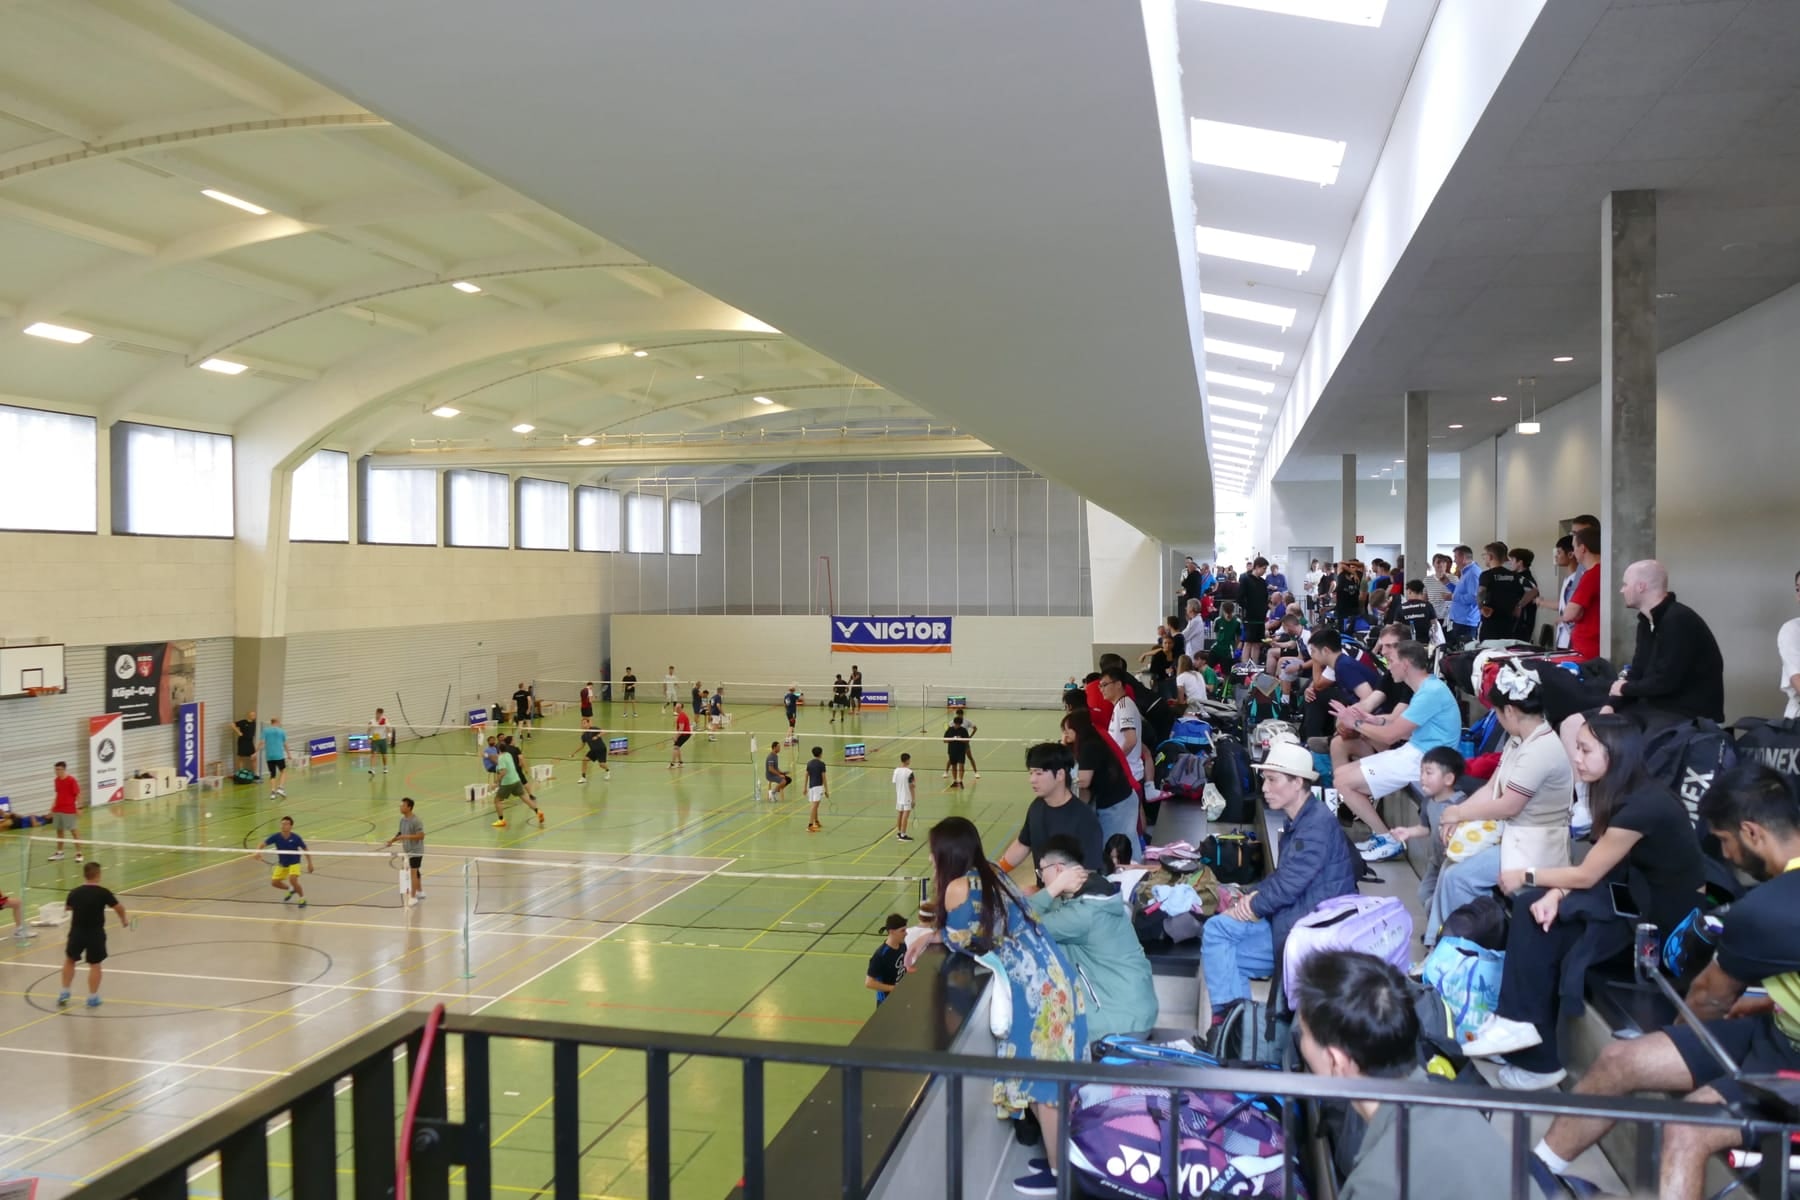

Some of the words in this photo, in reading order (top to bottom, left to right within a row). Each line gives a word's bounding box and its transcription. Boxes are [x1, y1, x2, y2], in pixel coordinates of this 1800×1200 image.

[863, 622, 947, 639] VICTOR
[185, 713, 194, 767] VICTOR
[144, 784, 151, 794] 2
[164, 776, 169, 788] 1
